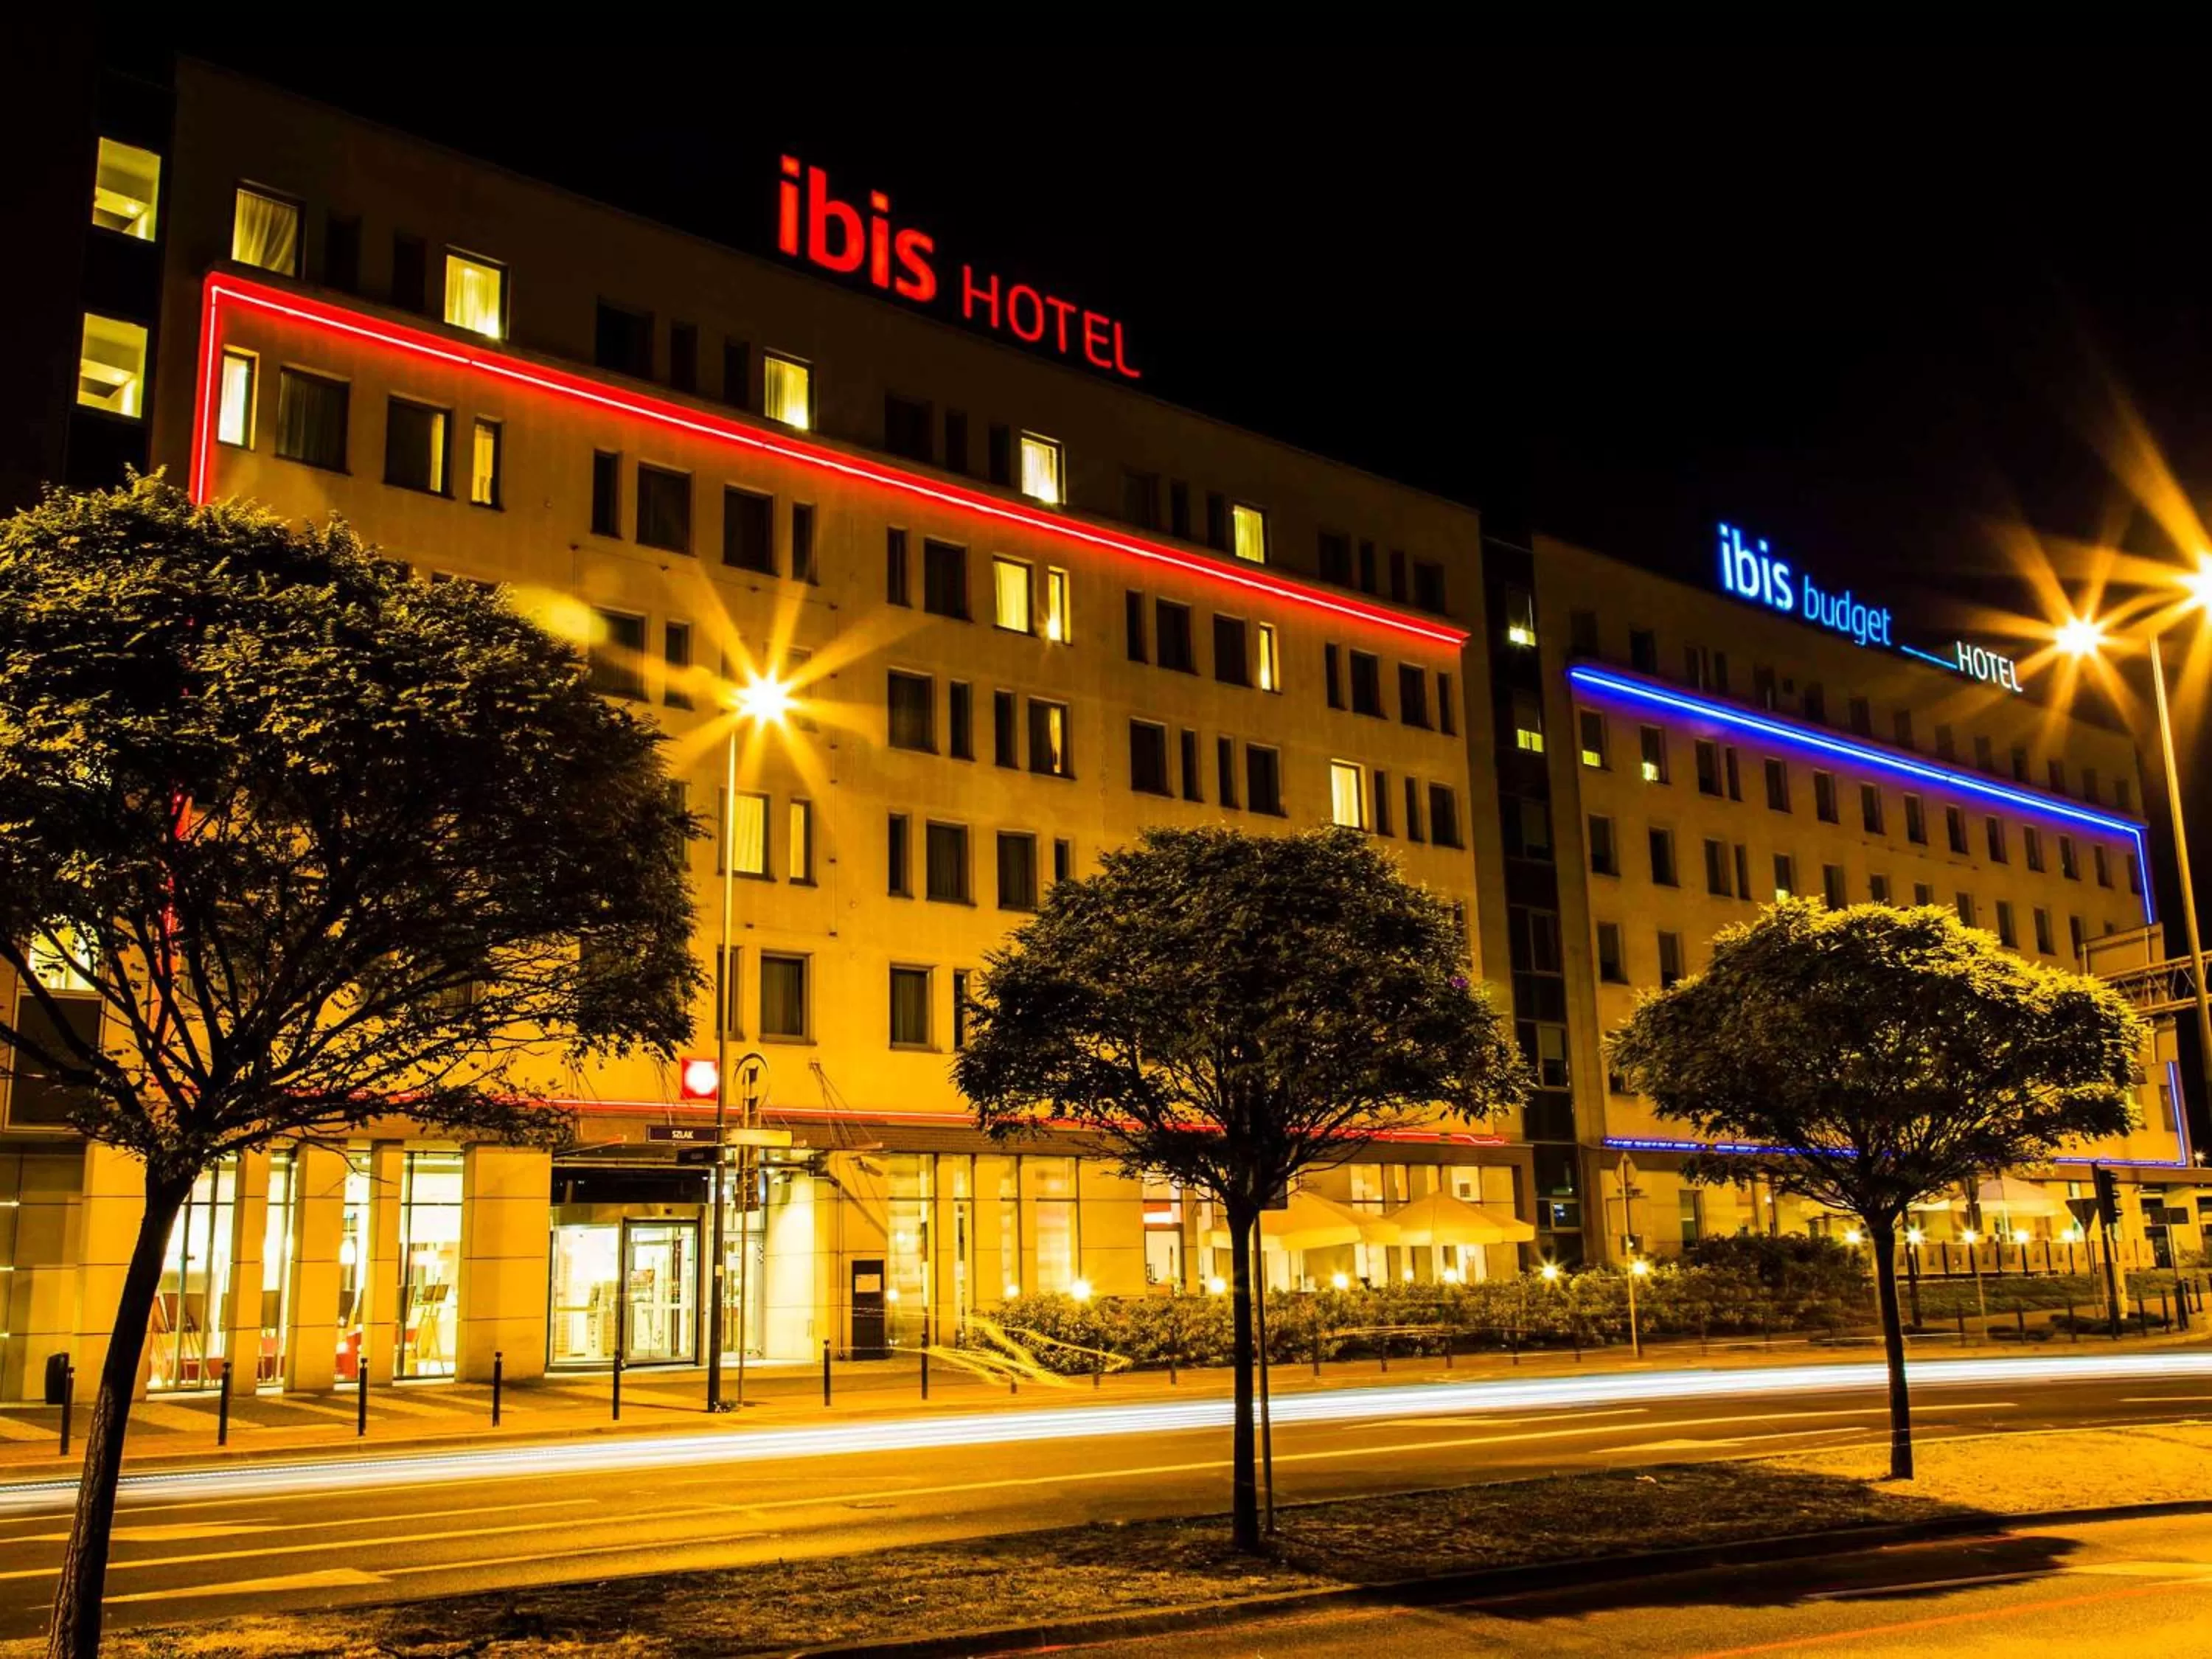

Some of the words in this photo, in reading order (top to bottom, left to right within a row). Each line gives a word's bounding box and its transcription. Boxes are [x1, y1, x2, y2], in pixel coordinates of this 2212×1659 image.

[779, 153, 937, 303] ibis
[962, 264, 1141, 378] HOTEL
[1719, 523, 1792, 611] ibis
[1804, 576, 1891, 646] budget
[1956, 641, 2023, 692] HOTEL
